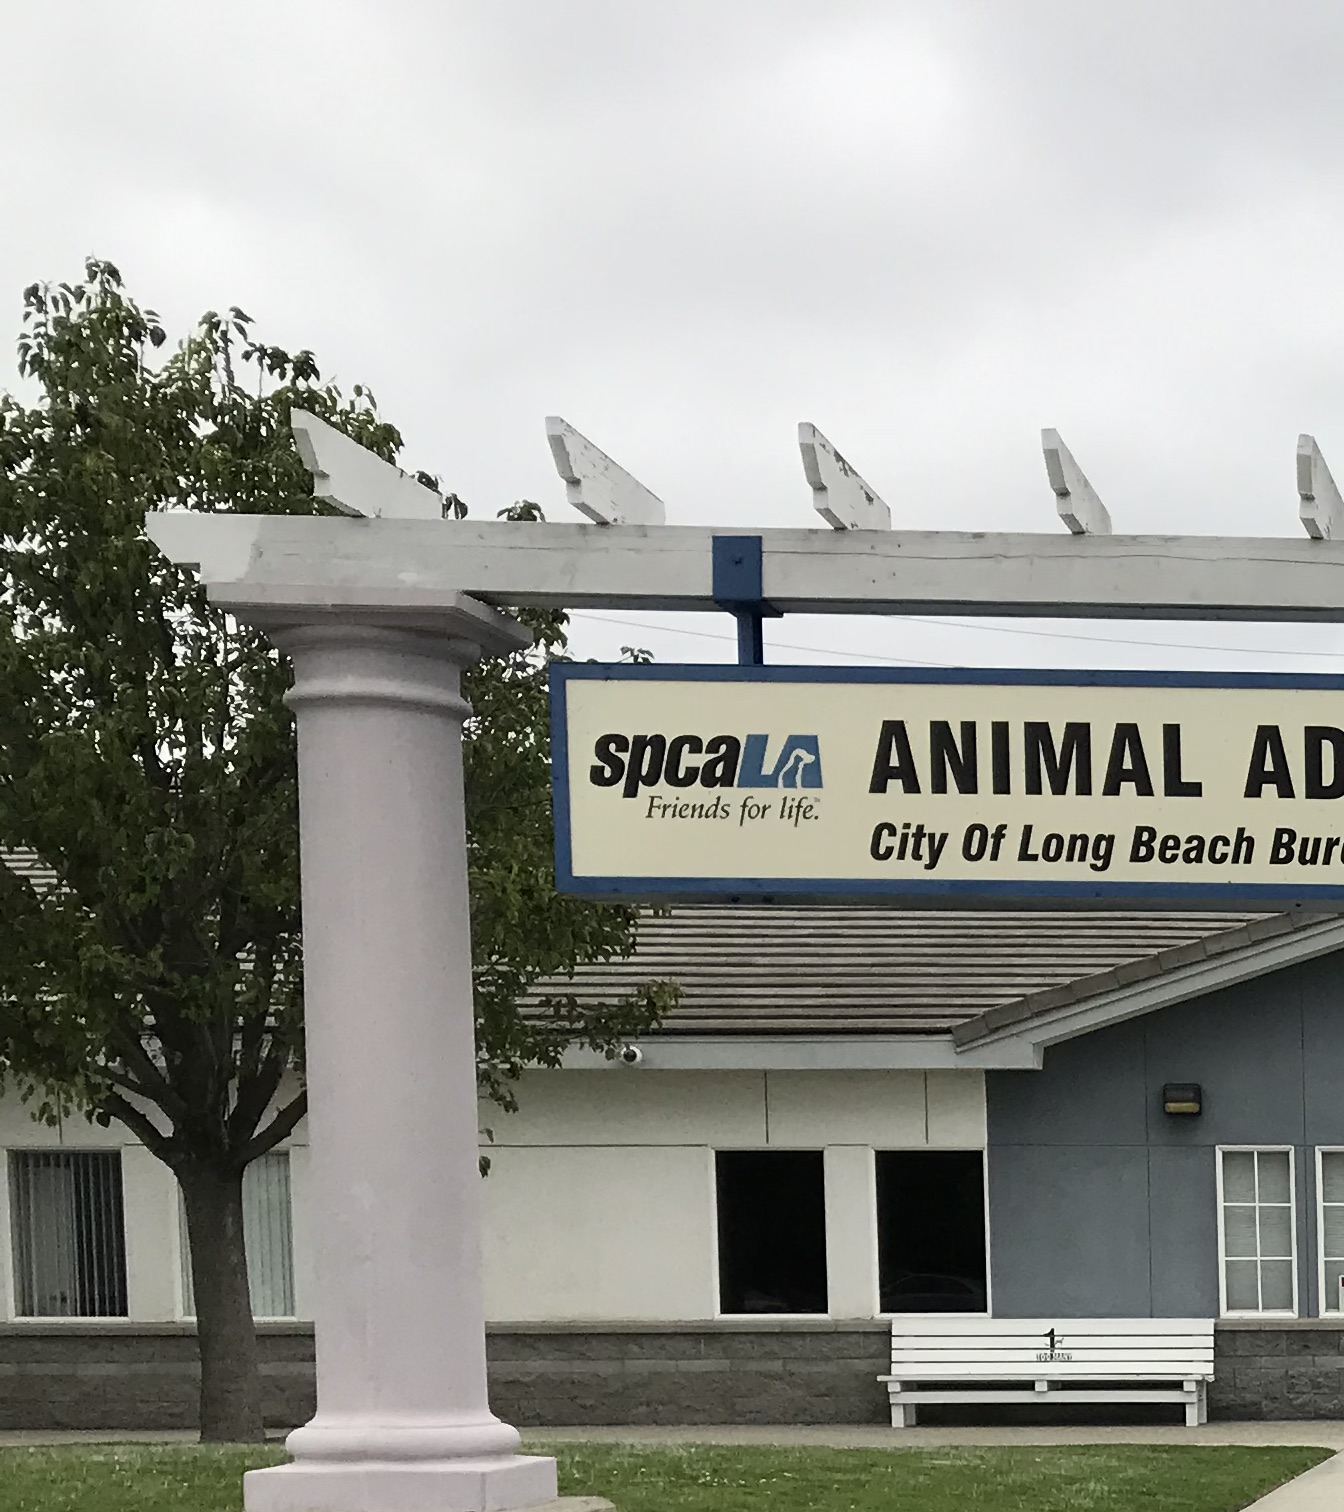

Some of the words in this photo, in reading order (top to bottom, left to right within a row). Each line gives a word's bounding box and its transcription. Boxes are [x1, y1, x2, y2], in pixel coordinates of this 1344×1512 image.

[589, 733, 824, 799] spcaLA
[868, 719, 1203, 798] ANIMAL
[645, 795, 731, 820] Friends
[739, 795, 772, 827] for
[870, 821, 949, 871] City
[961, 823, 1008, 863] Of
[1017, 824, 1116, 872] Long
[1128, 825, 1255, 866] Beach
